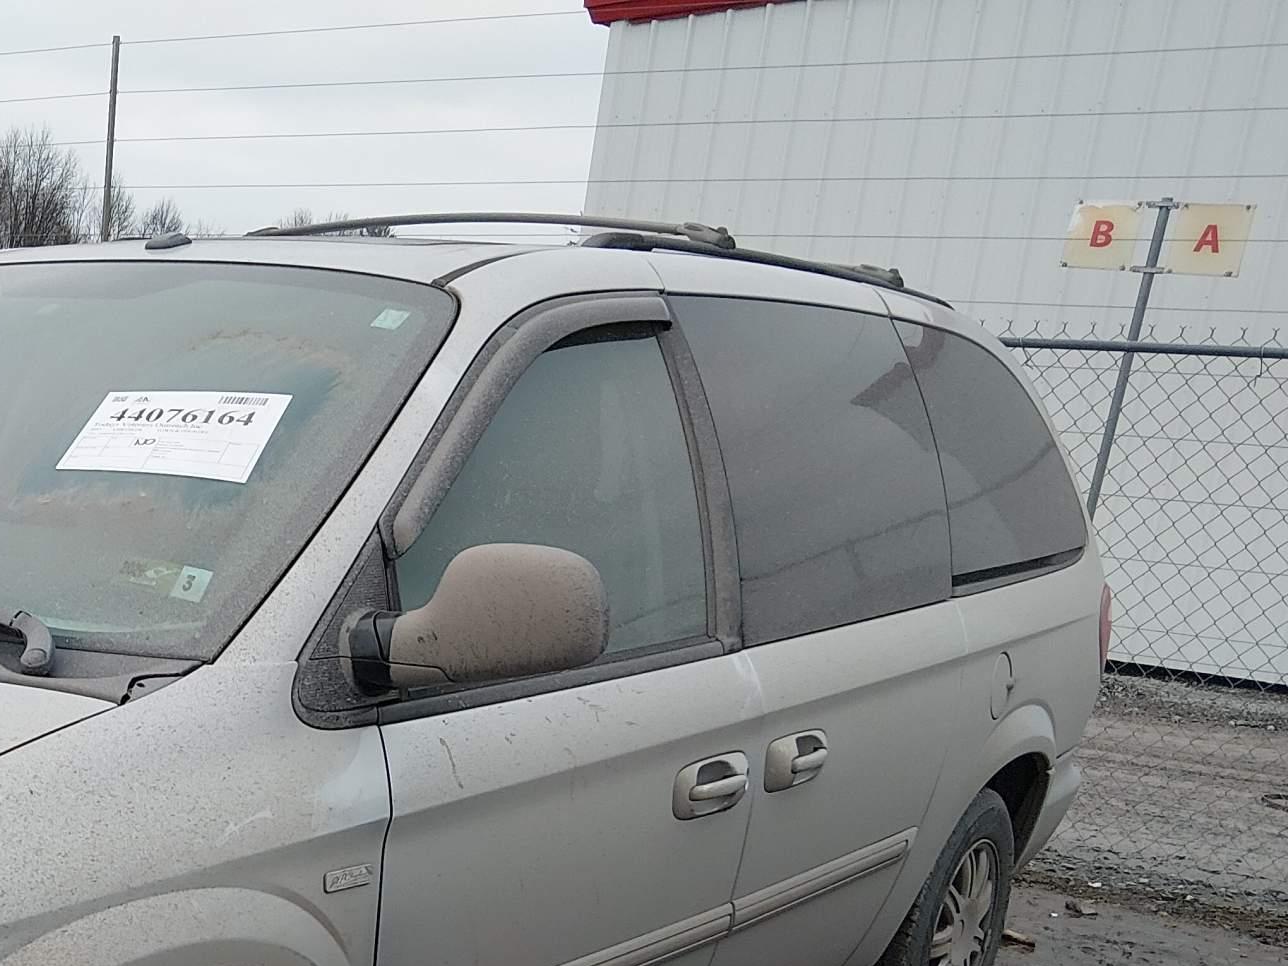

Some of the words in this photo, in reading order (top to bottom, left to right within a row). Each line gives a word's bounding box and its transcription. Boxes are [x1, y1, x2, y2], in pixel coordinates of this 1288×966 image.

[1089, 220, 1115, 248] B
[1193, 224, 1220, 253] A
[110, 407, 257, 426] 44076164
[182, 574, 197, 592] 3
